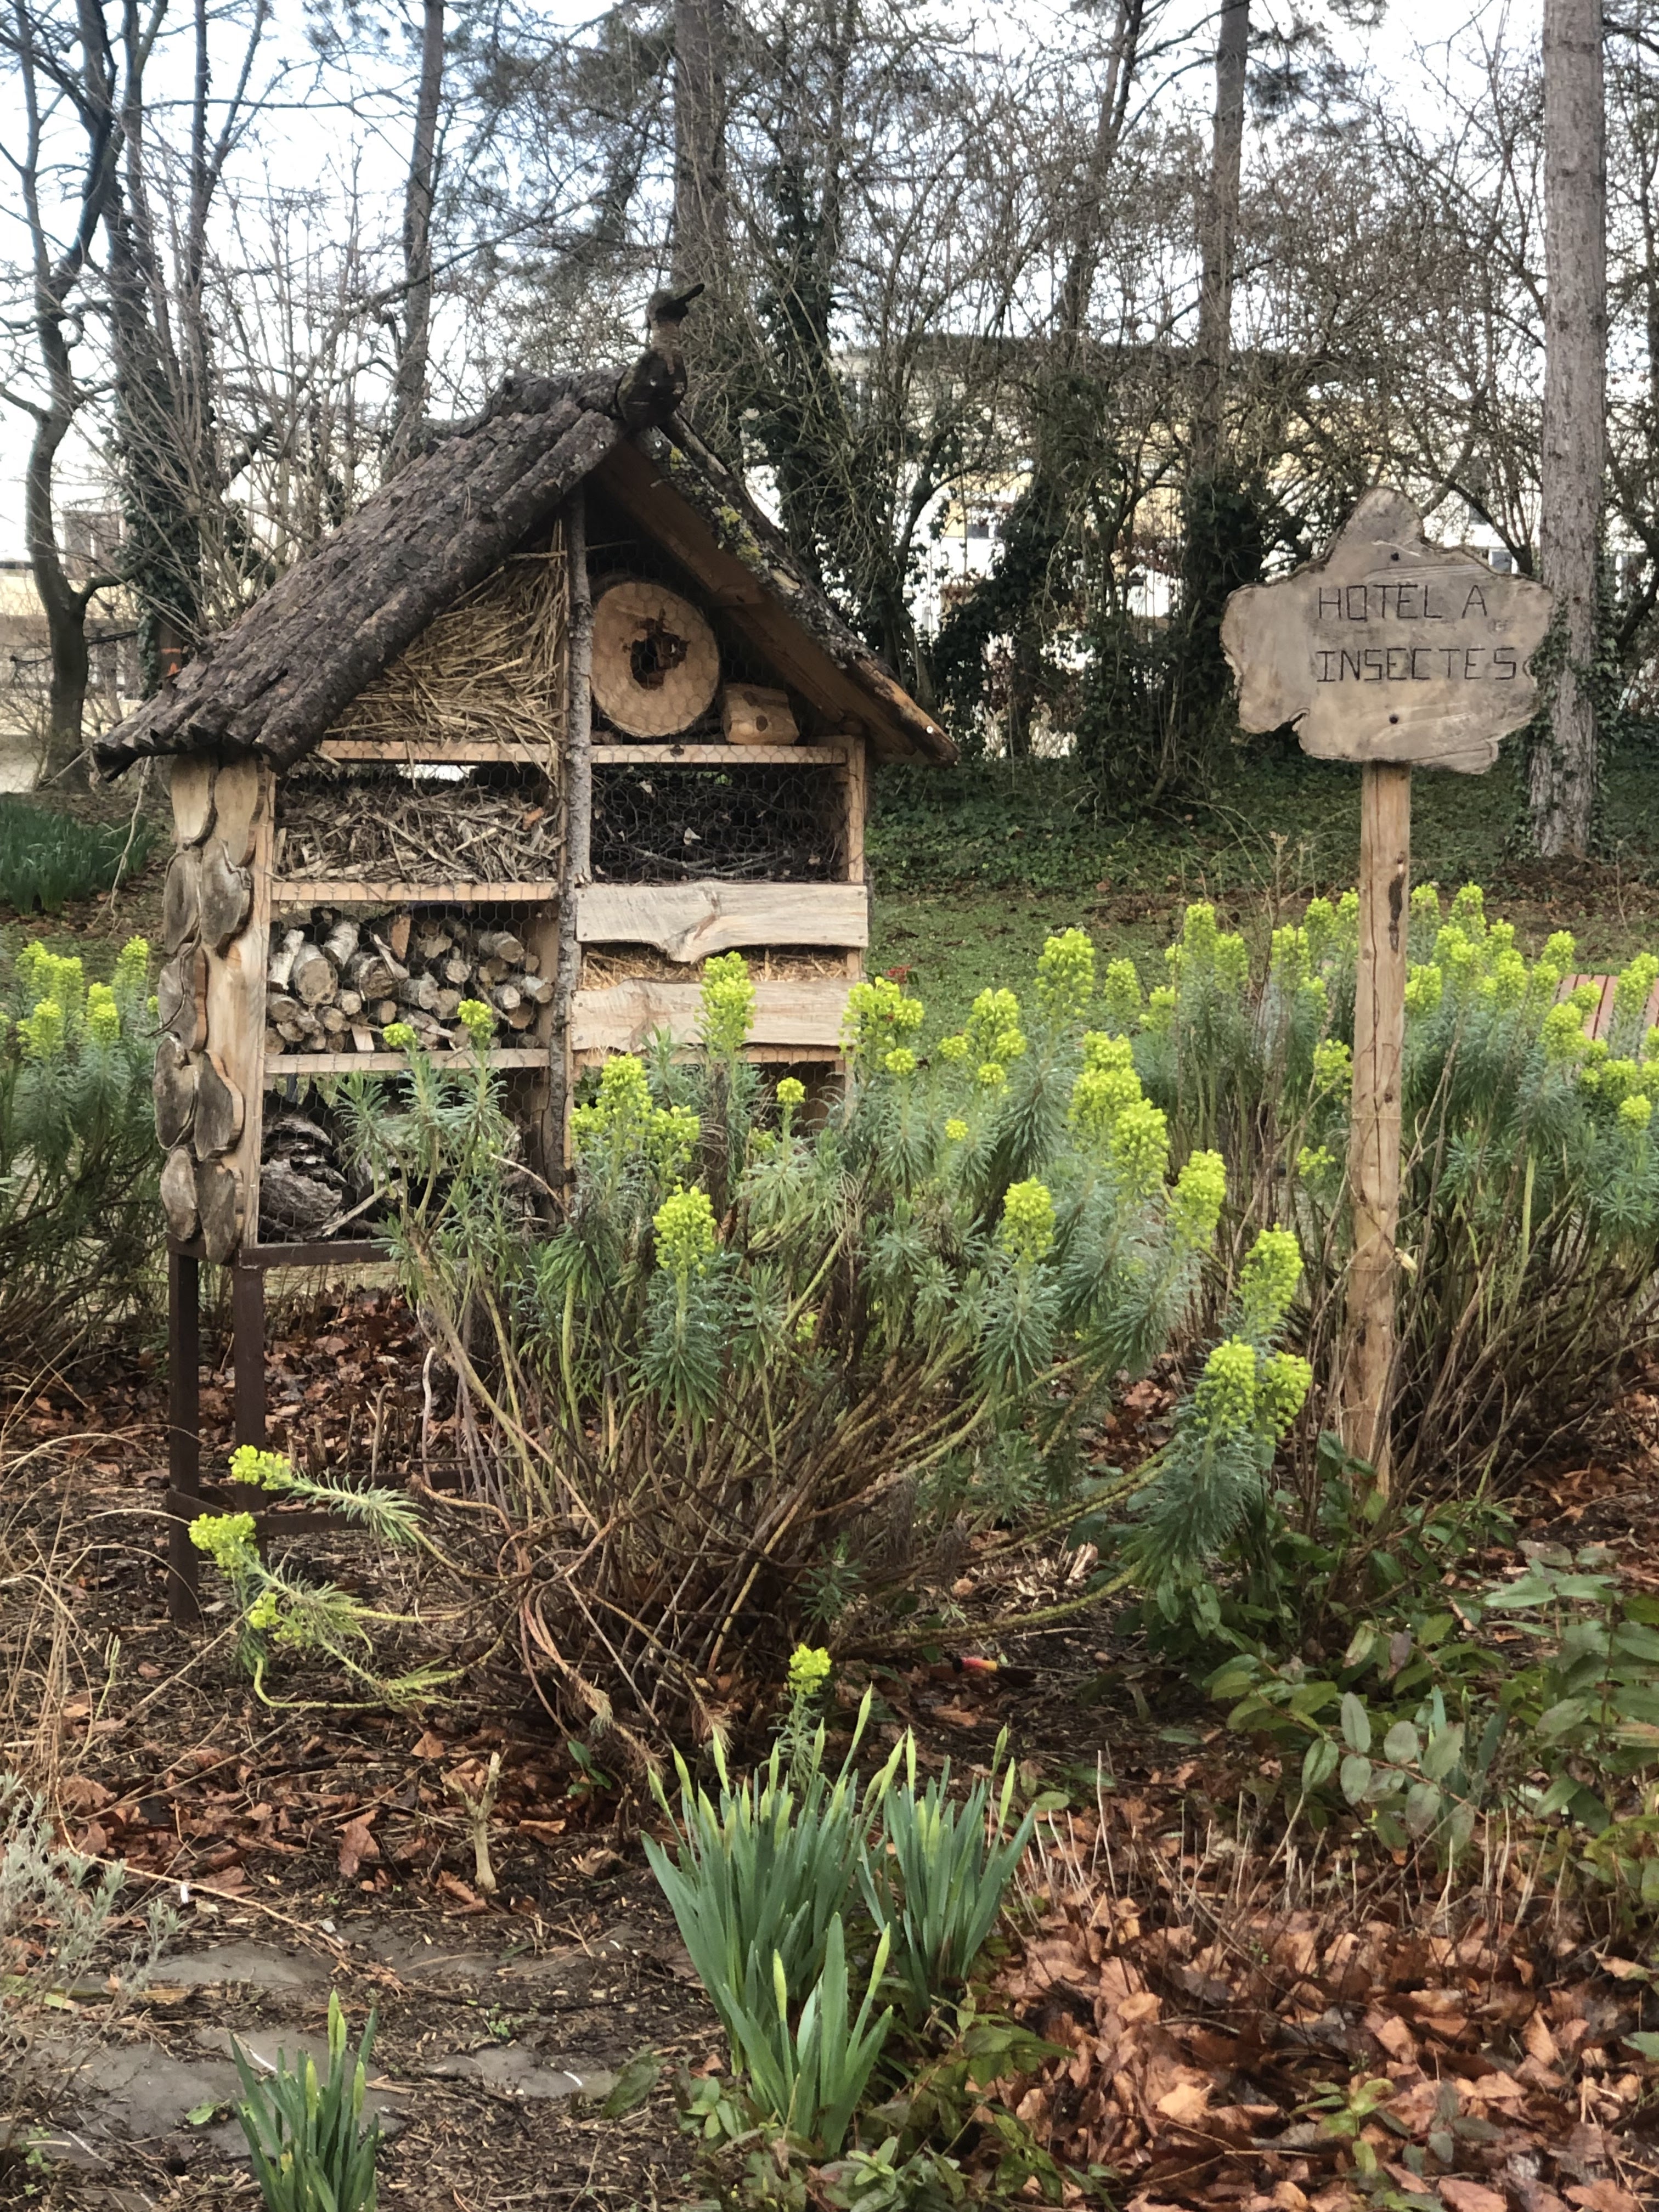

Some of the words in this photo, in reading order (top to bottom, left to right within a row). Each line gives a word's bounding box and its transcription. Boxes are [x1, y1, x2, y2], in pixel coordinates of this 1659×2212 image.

[1318, 584, 1443, 622] HOTEL
[1461, 584, 1488, 619] A
[1316, 647, 1517, 682] INSECTES
